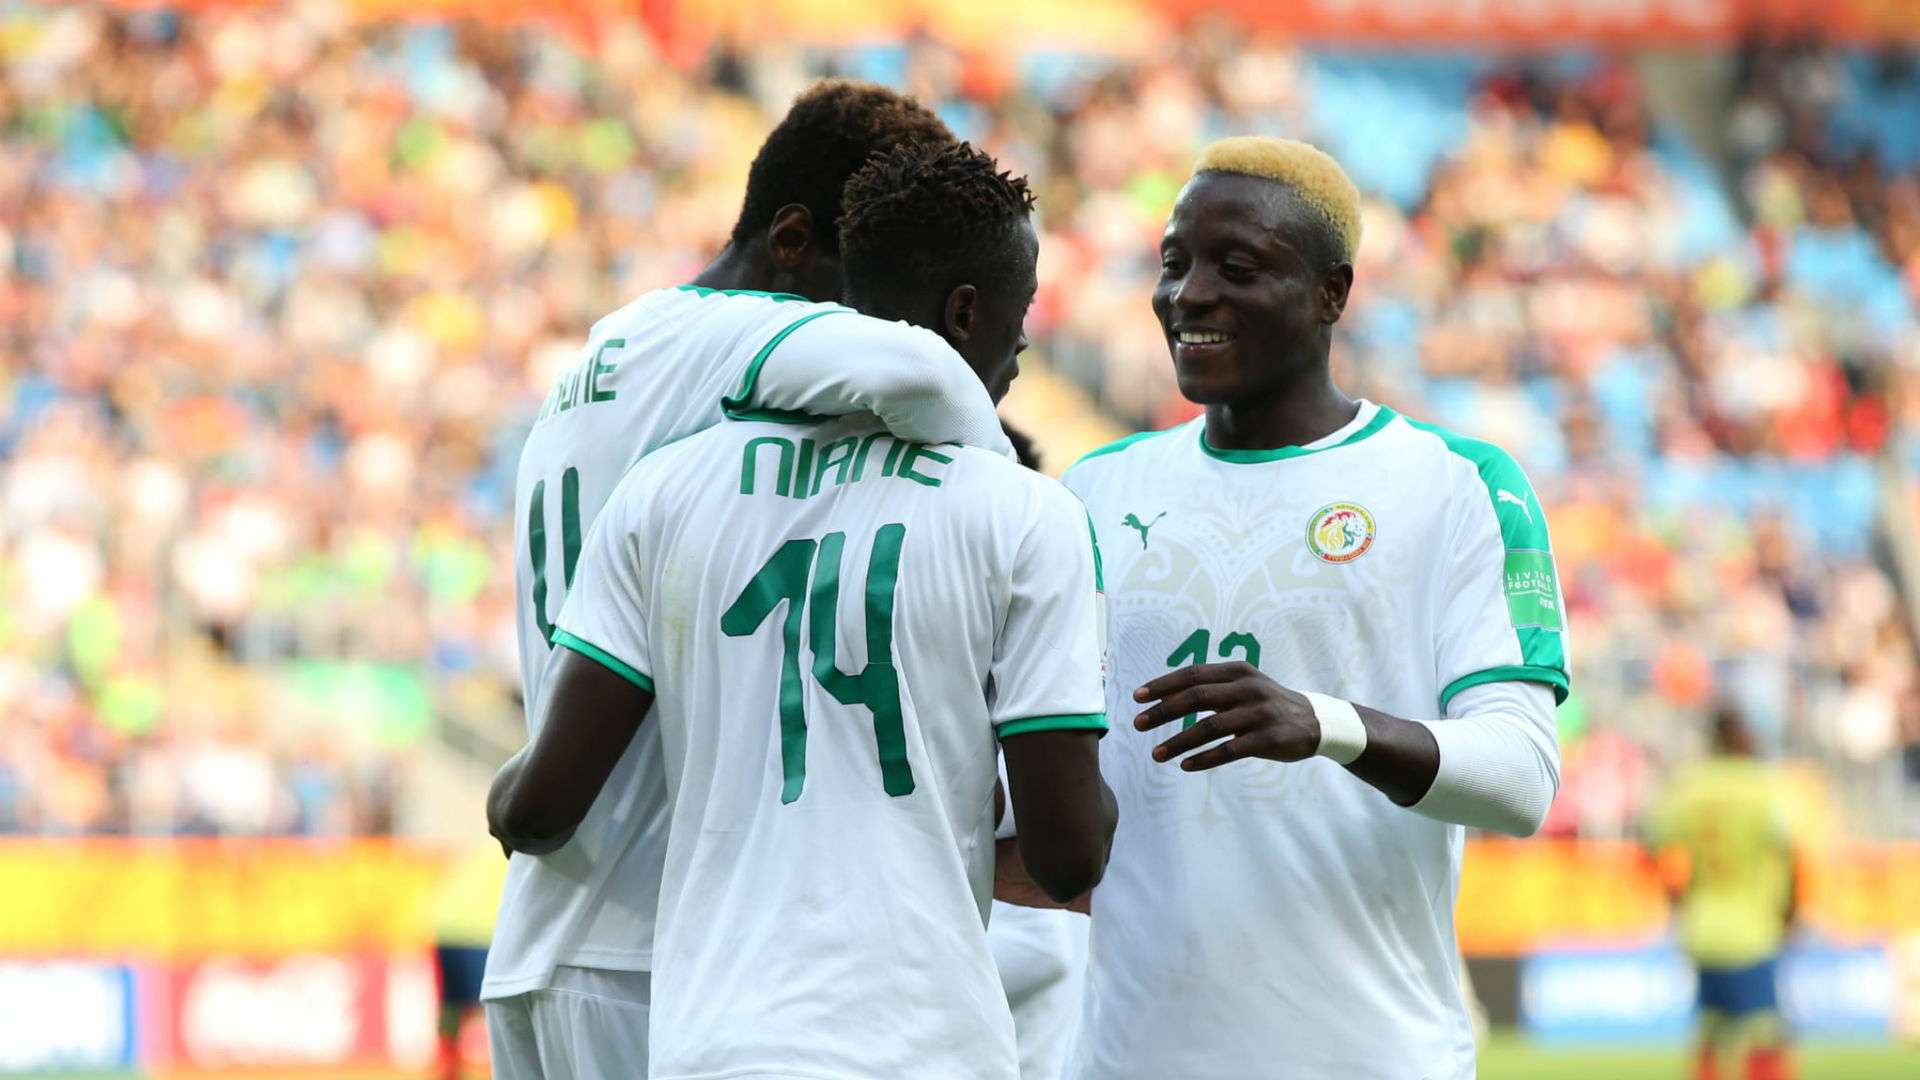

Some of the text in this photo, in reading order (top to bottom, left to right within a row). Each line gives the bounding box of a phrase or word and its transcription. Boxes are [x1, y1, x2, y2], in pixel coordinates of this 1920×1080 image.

[739, 432, 965, 500] NIANE
[720, 522, 916, 806] 14
[1166, 628, 1262, 733] 1
